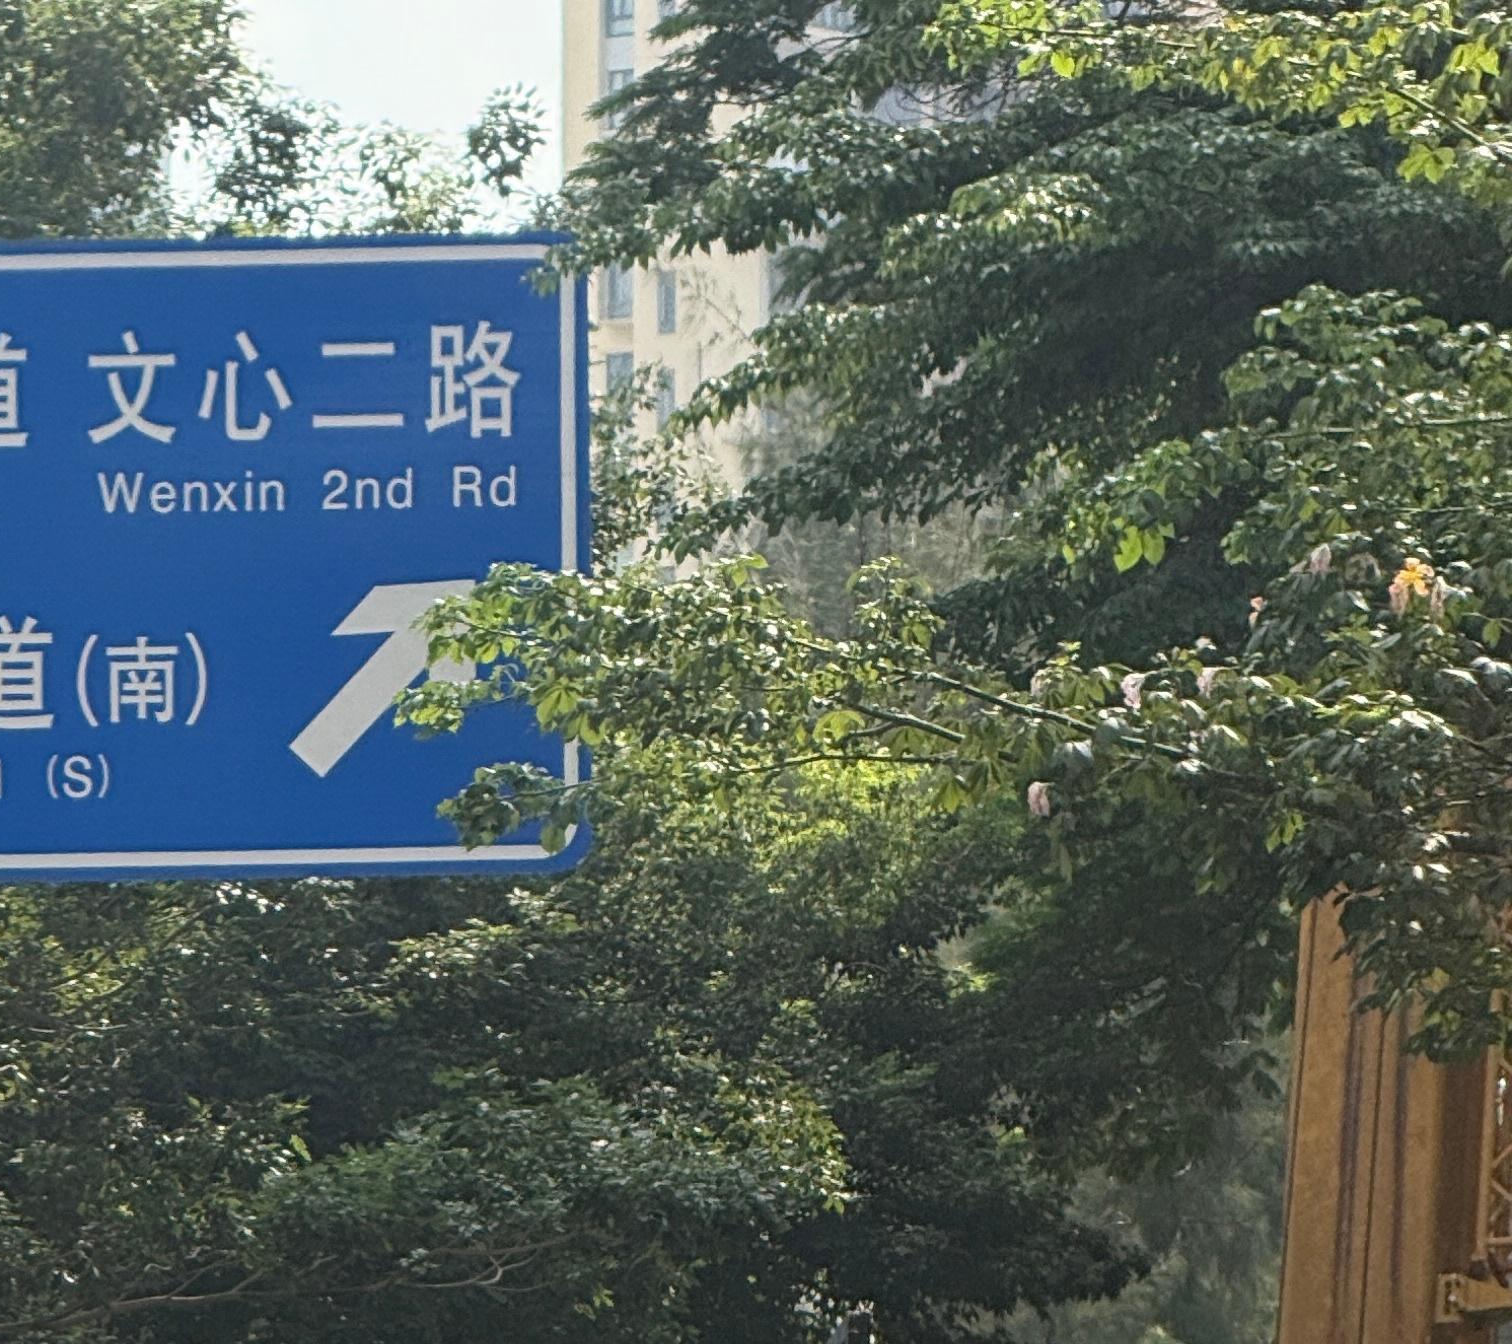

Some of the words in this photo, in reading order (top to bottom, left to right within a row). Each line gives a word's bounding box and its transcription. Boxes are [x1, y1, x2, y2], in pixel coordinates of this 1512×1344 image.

[87, 319, 522, 444] 文心二路
[97, 470, 285, 514] Wenxin
[322, 466, 414, 510] 2nd
[452, 464, 517, 508] Rd
[46, 754, 111, 799] (S)
